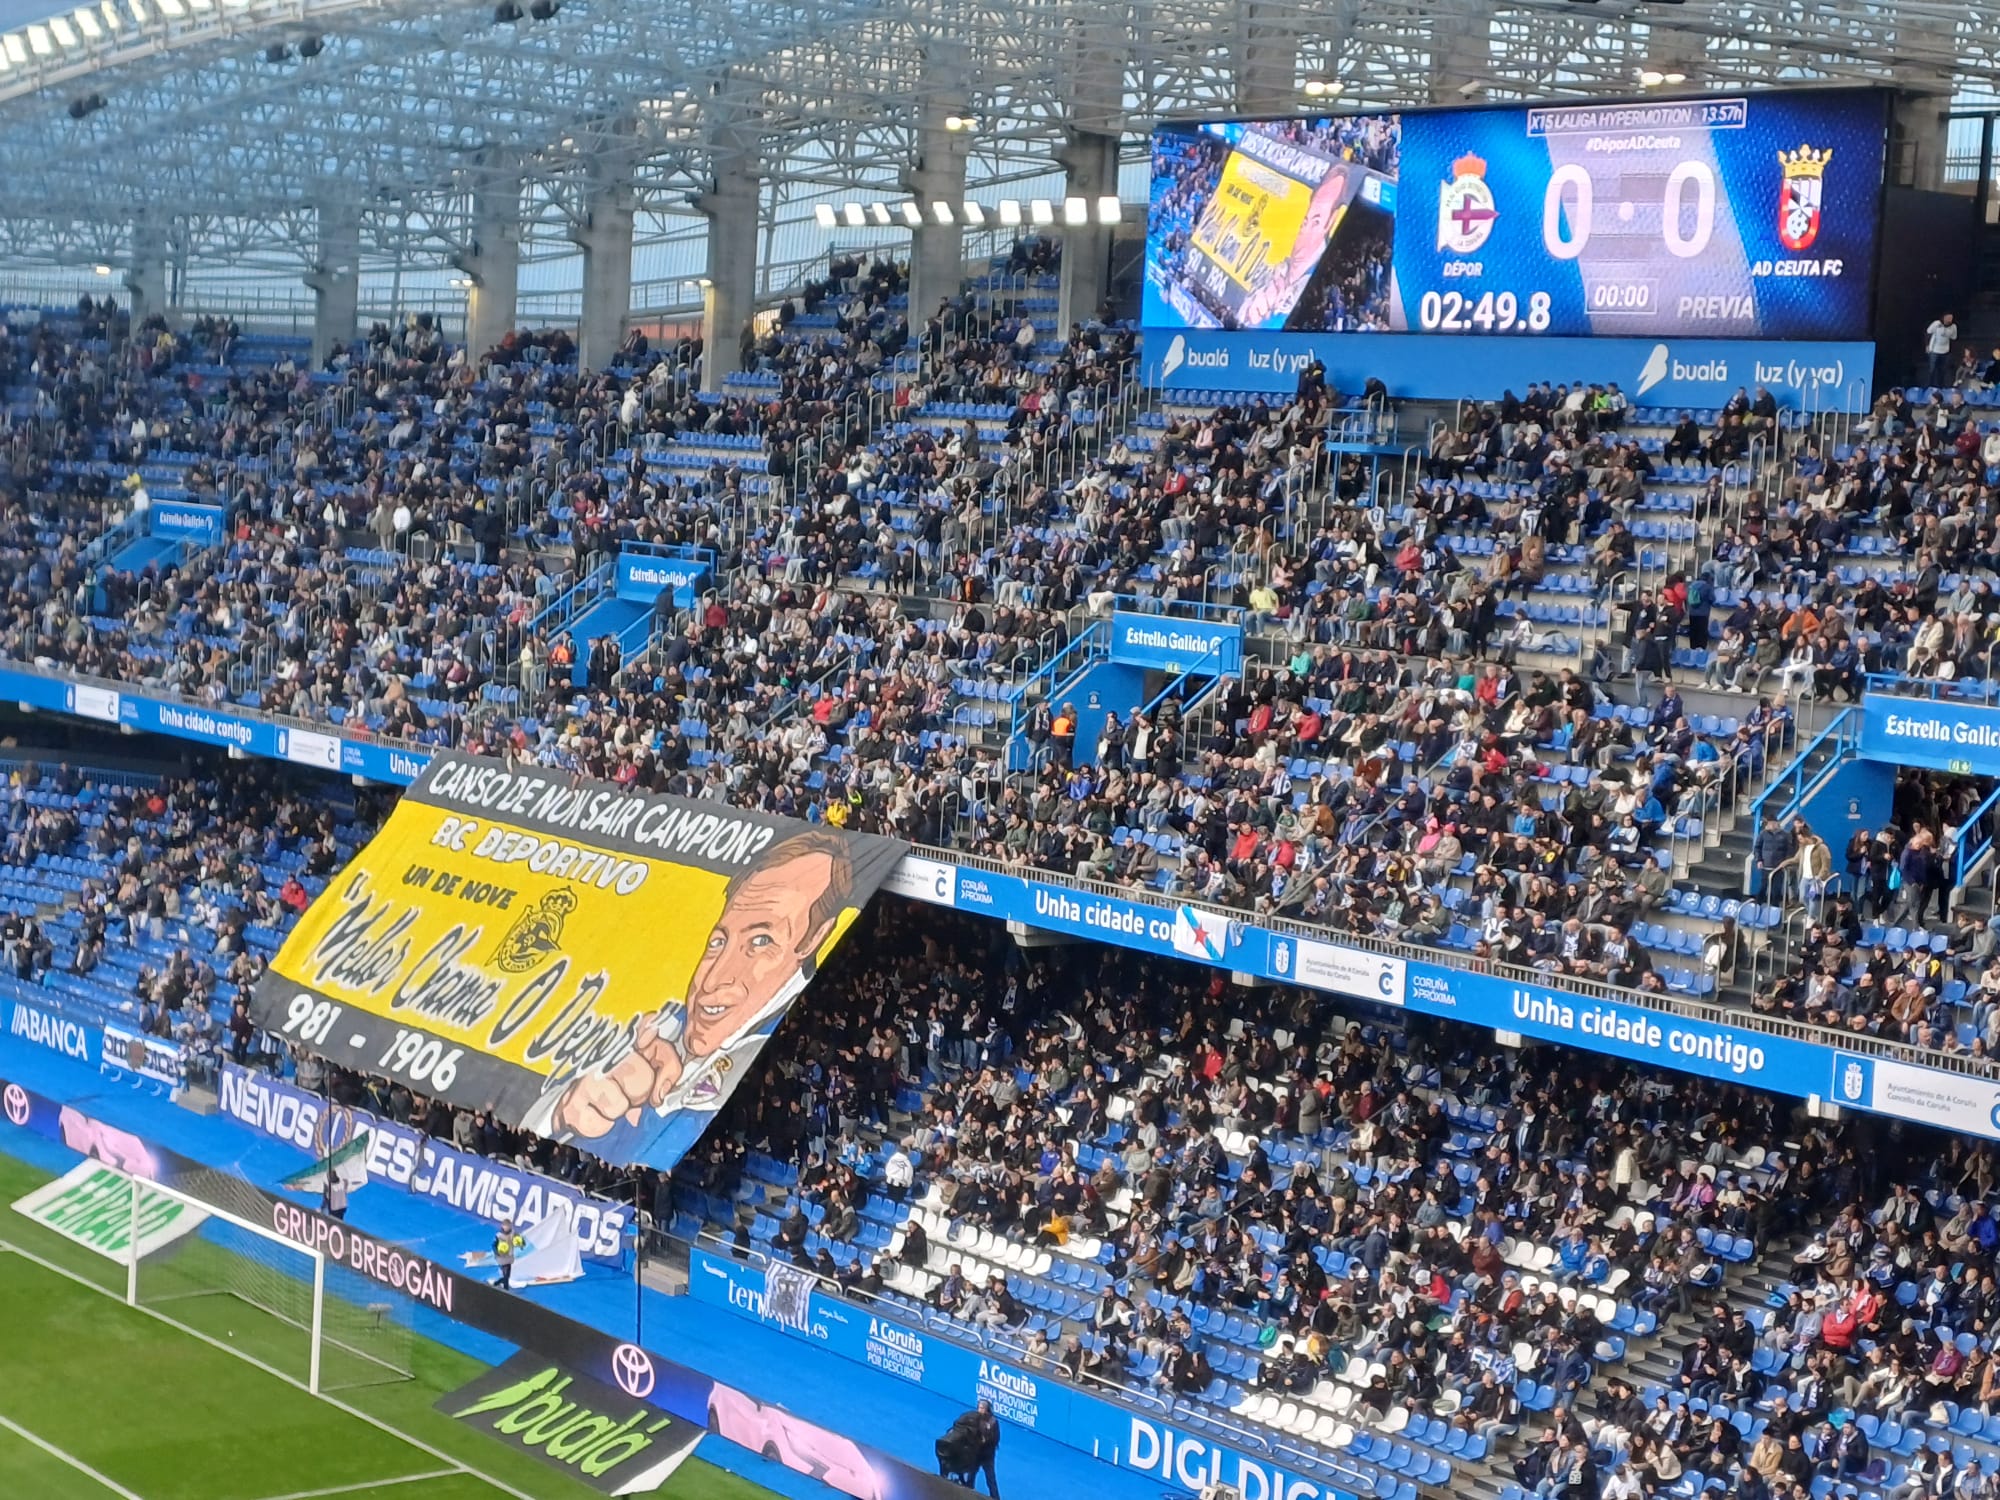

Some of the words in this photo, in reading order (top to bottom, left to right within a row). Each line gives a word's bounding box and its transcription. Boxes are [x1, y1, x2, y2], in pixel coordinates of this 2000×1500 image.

[1554, 112, 1600, 129] LALIGA
[1600, 107, 1692, 127] HYPERMOTION
[1543, 163, 1592, 259] 0
[1663, 160, 1716, 258] 0
[1443, 261, 1483, 277] DÉPOR
[1751, 260, 1773, 277] AD
[1774, 260, 1820, 277] CEUTA
[1820, 259, 1844, 276] FC
[1420, 290, 1552, 332] 02:49.8
[1594, 284, 1650, 309] 00:00
[1679, 295, 1755, 321] PREVIA
[1187, 347, 1229, 367] bualá
[1248, 347, 1270, 369] luz
[1673, 359, 1728, 381] bualá
[1755, 360, 1783, 383] luz
[1787, 359, 1807, 389] (y
[1810, 359, 1844, 390] ya)
[629, 565, 658, 584] Estrella
[658, 569, 688, 587] Galicia
[1126, 627, 1168, 648] Estrella
[1168, 632, 1208, 653] Galicia
[159, 704, 183, 728] Unha
[184, 711, 216, 735] cidade
[216, 720, 252, 746] contigo
[1885, 714, 1951, 742] Estrella
[389, 752, 419, 778] Unha
[428, 760, 513, 808] CANSO
[511, 776, 545, 815] DE
[528, 783, 593, 830] NON
[580, 790, 645, 839] SAIR
[634, 802, 775, 865] CAMPION?
[471, 826, 650, 897] DEPORTIVO
[402, 864, 434, 888] UN
[431, 871, 463, 896] DE
[459, 879, 518, 911] NOVE
[1035, 889, 1081, 922] Unha
[1084, 901, 1145, 935] cidade
[1412, 975, 1449, 992] CORUÑA
[1418, 986, 1457, 1007] PRÓXIMA
[489, 956, 571, 1048] O
[282, 992, 342, 1046] 981
[377, 1029, 465, 1092] 1906
[1513, 989, 1574, 1030] Unha
[1580, 1006, 1662, 1048] cidade
[1669, 1029, 1766, 1074] contigo
[219, 1070, 319, 1149] NENOS
[272, 1200, 346, 1260] GRUPO
[349, 1228, 454, 1313] BREOGÁN
[869, 1318, 879, 1336] A
[880, 1322, 923, 1354] Coruña
[865, 1339, 886, 1357] UNHA
[887, 1348, 925, 1373] PROVINCIA
[867, 1351, 882, 1367] POR
[882, 1357, 922, 1383] DESCUBRIR
[978, 1360, 988, 1380] A
[990, 1364, 1037, 1398] Coruña
[975, 1383, 997, 1401] UNHA
[998, 1391, 1038, 1417] PROVINCIA
[993, 1401, 1036, 1428] DESCUBRIR
[493, 1374, 672, 1478] bualá
[1128, 1417, 1222, 1491] DIGI
[1238, 1457, 1336, 1500] DI
